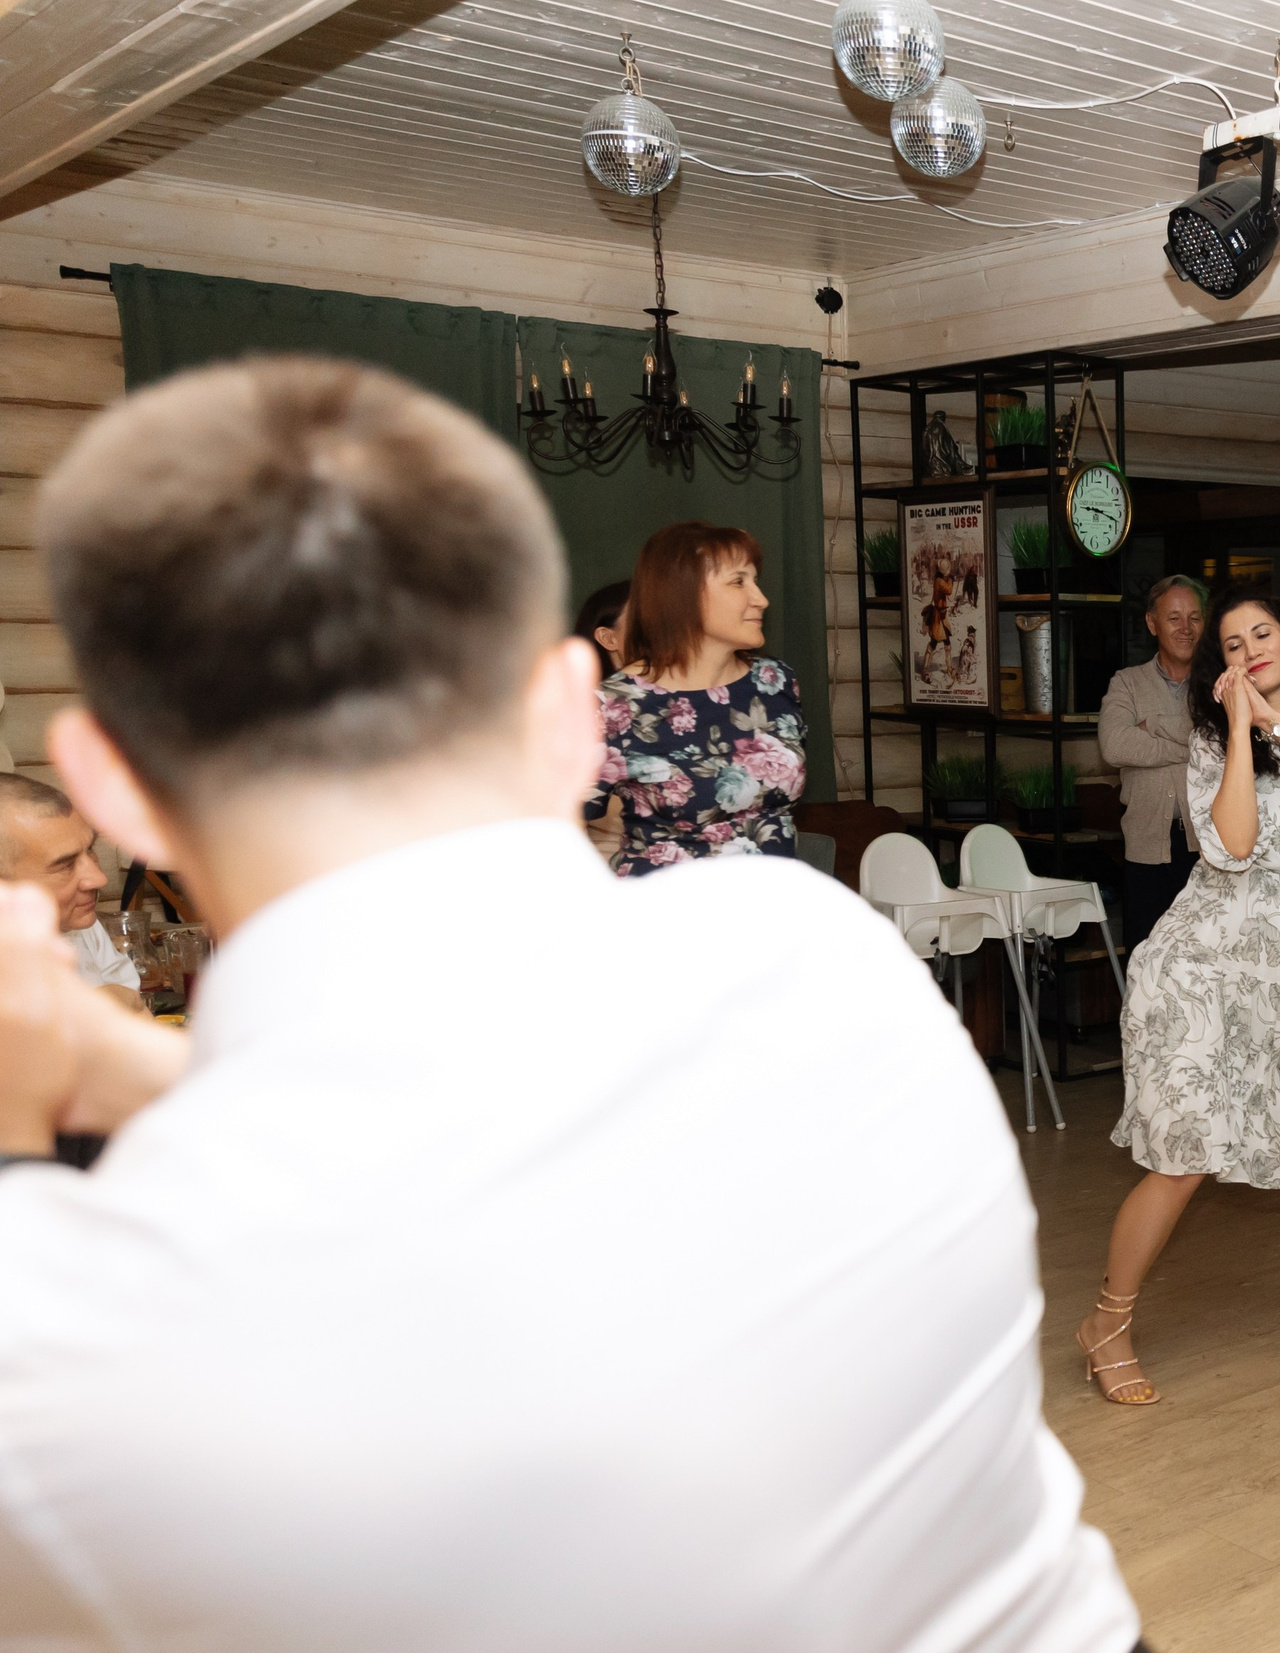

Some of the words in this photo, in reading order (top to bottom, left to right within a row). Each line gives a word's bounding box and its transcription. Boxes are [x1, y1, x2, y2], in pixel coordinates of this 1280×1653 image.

[910, 508, 923, 518] BIG
[924, 507, 946, 517] GAME
[949, 505, 982, 516] HUNTING
[954, 516, 978, 529] USSR
[1090, 535, 1099, 549] 6
